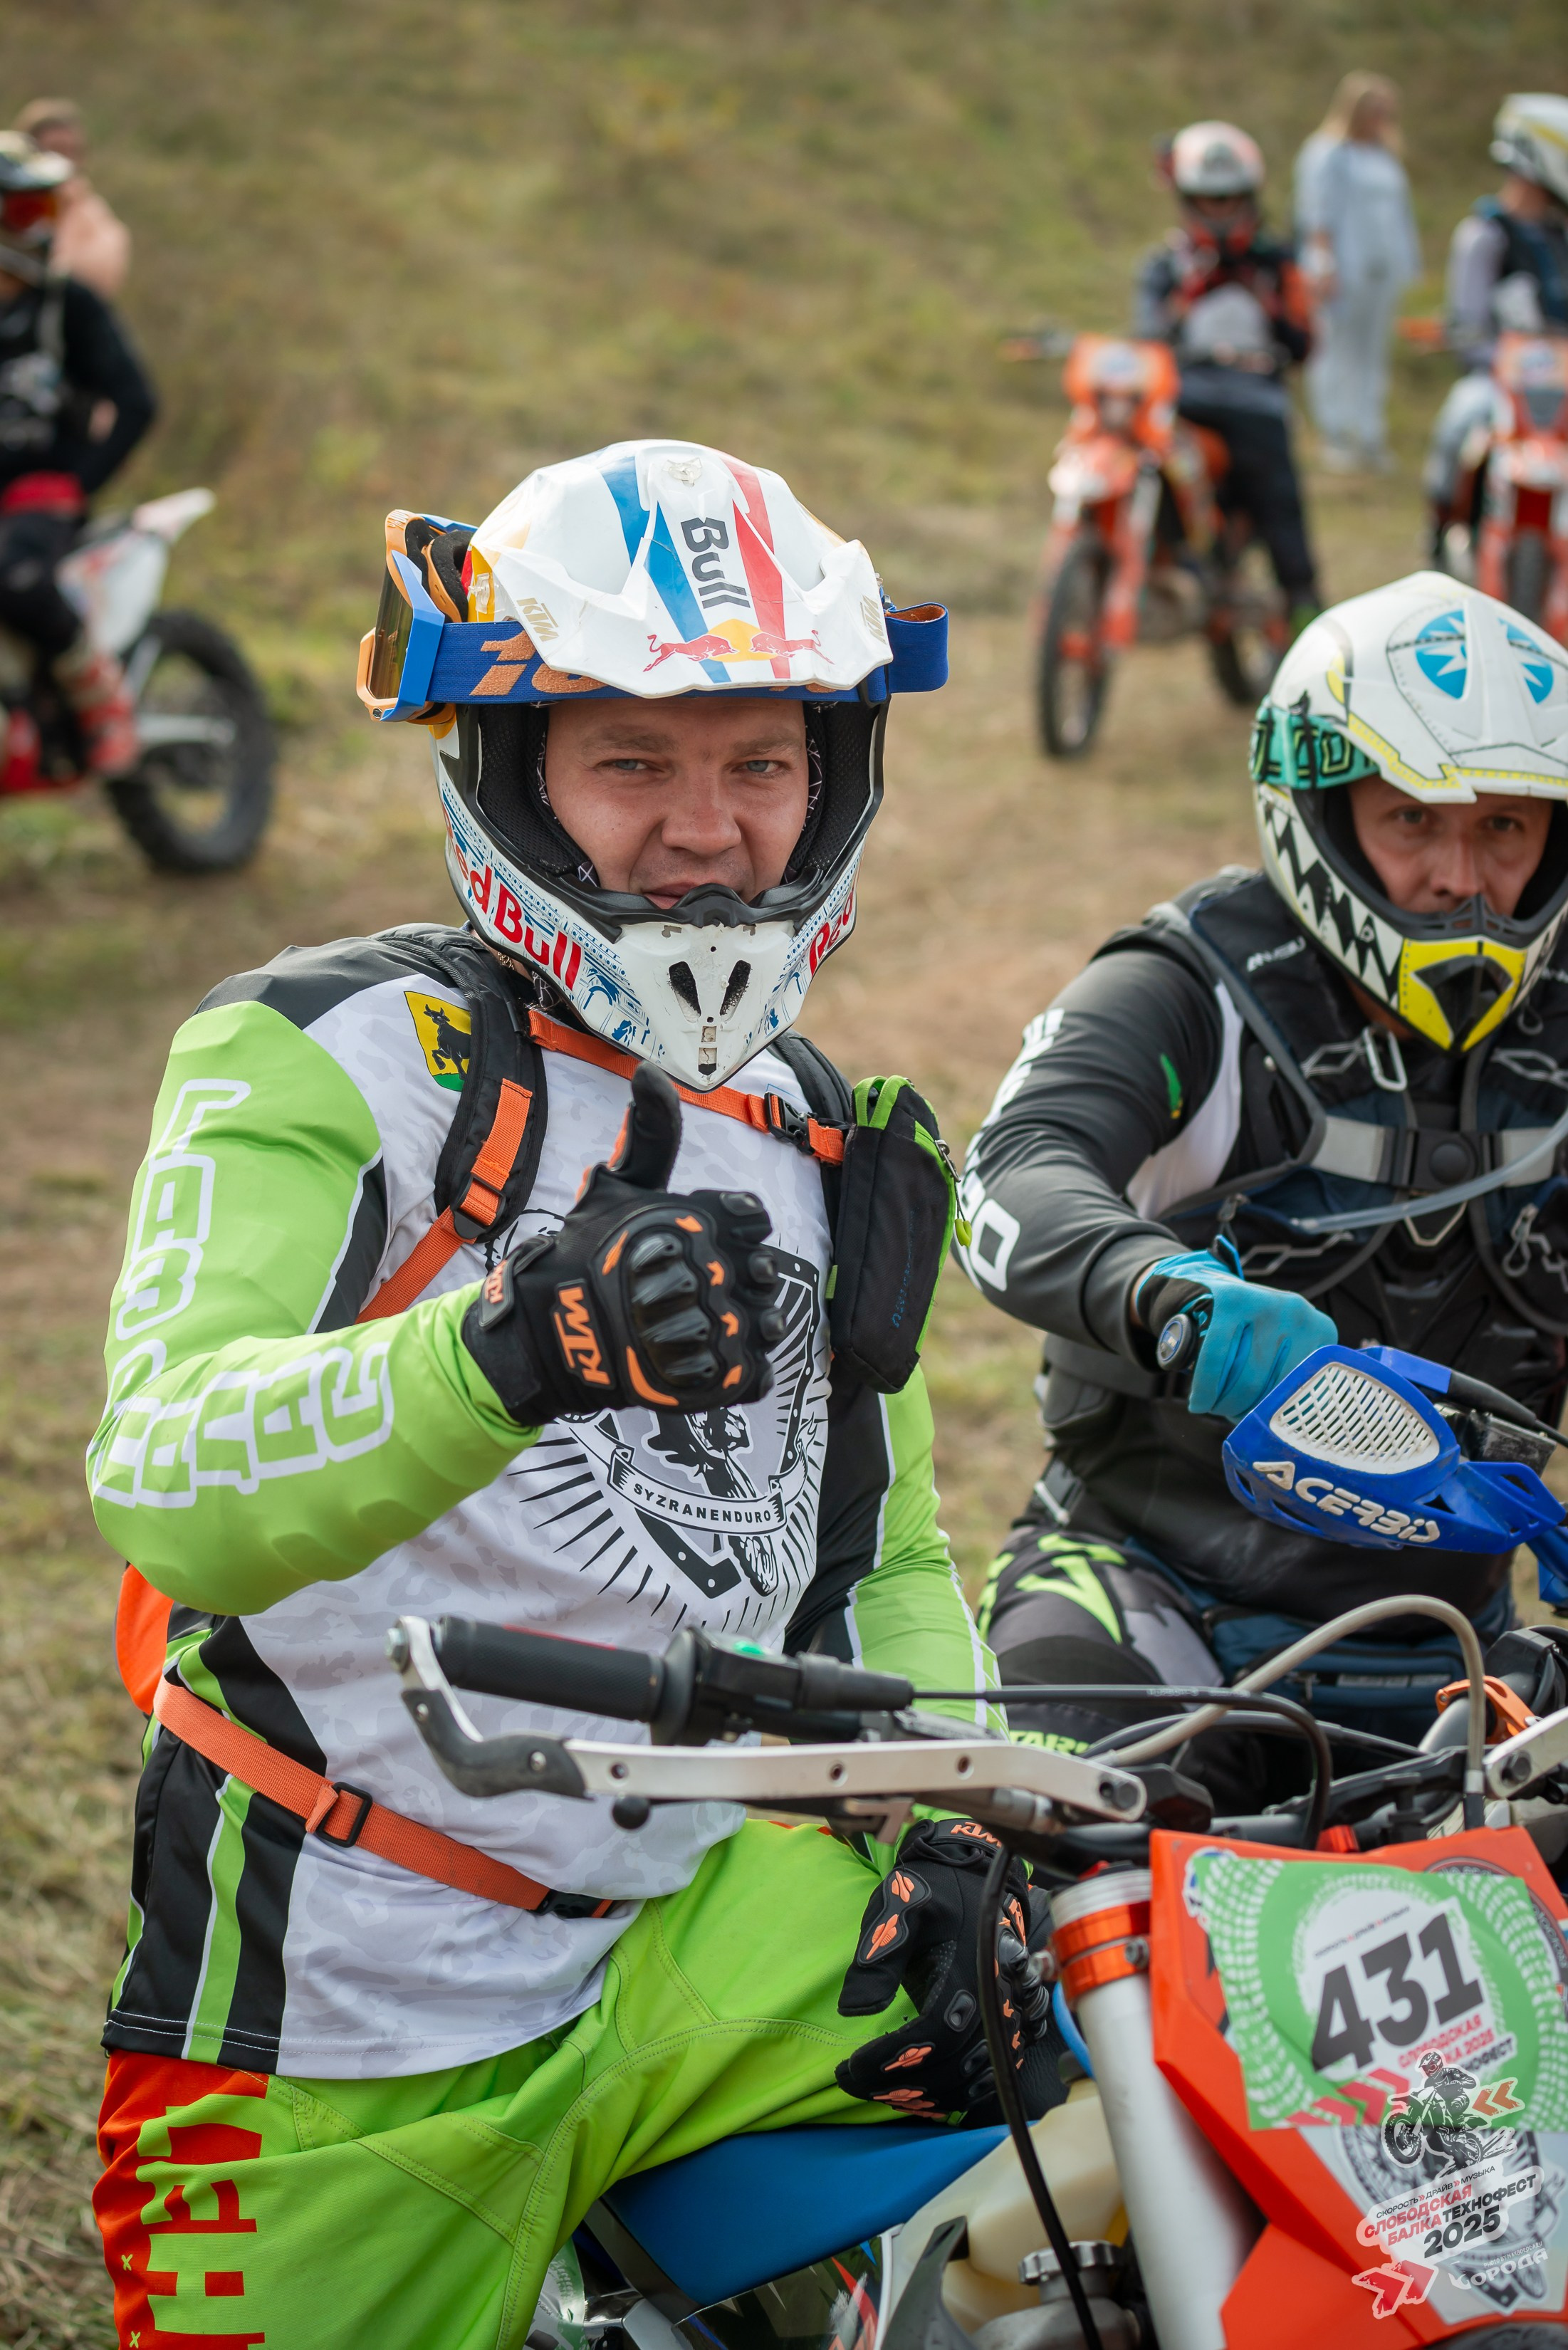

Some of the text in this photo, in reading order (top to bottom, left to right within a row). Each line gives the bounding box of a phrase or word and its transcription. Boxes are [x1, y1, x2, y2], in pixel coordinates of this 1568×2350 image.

[681, 517, 751, 610] Bull
[516, 597, 560, 642] KTM
[493, 882, 582, 991] Bull
[554, 1286, 611, 1385] KTM
[632, 1482, 772, 1523] SYZRANENDURO
[951, 1822, 1003, 1849] KTM
[1312, 1913, 1484, 2073] 431
